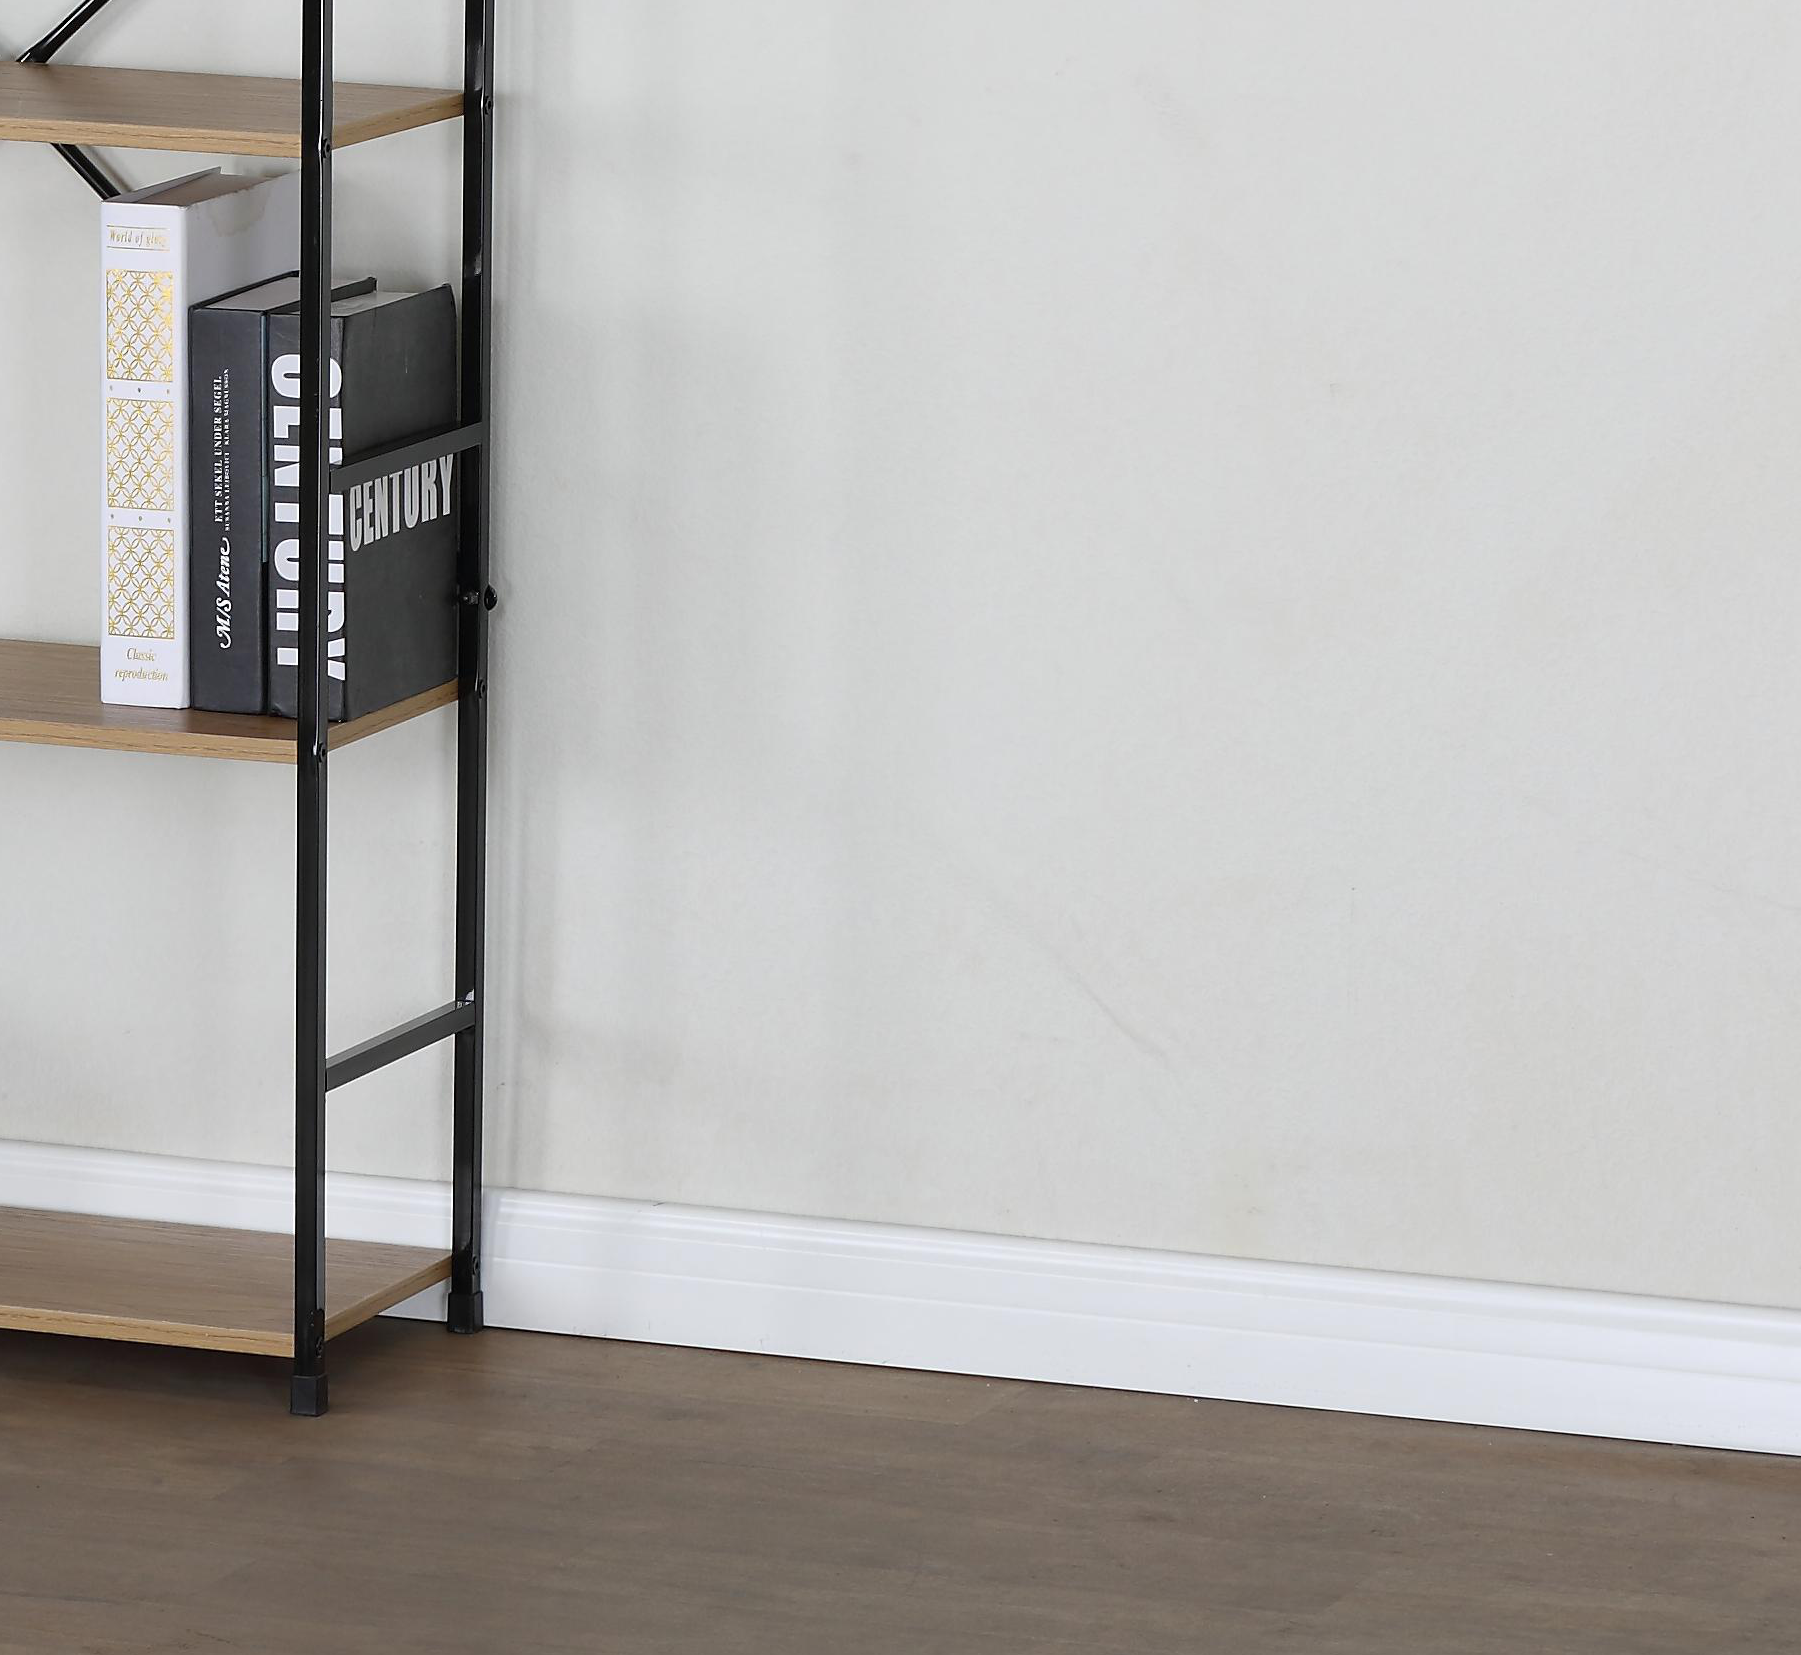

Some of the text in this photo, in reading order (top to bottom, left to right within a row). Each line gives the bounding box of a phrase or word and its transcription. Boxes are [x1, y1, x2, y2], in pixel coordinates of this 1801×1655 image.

[110, 230, 133, 243] World
[135, 231, 144, 247] of
[213, 376, 223, 523] ETT SEKEL UNDER SEGEL
[349, 453, 454, 551] CENTURY
[215, 536, 232, 649] M/S Atene
[127, 647, 155, 661] Classic
